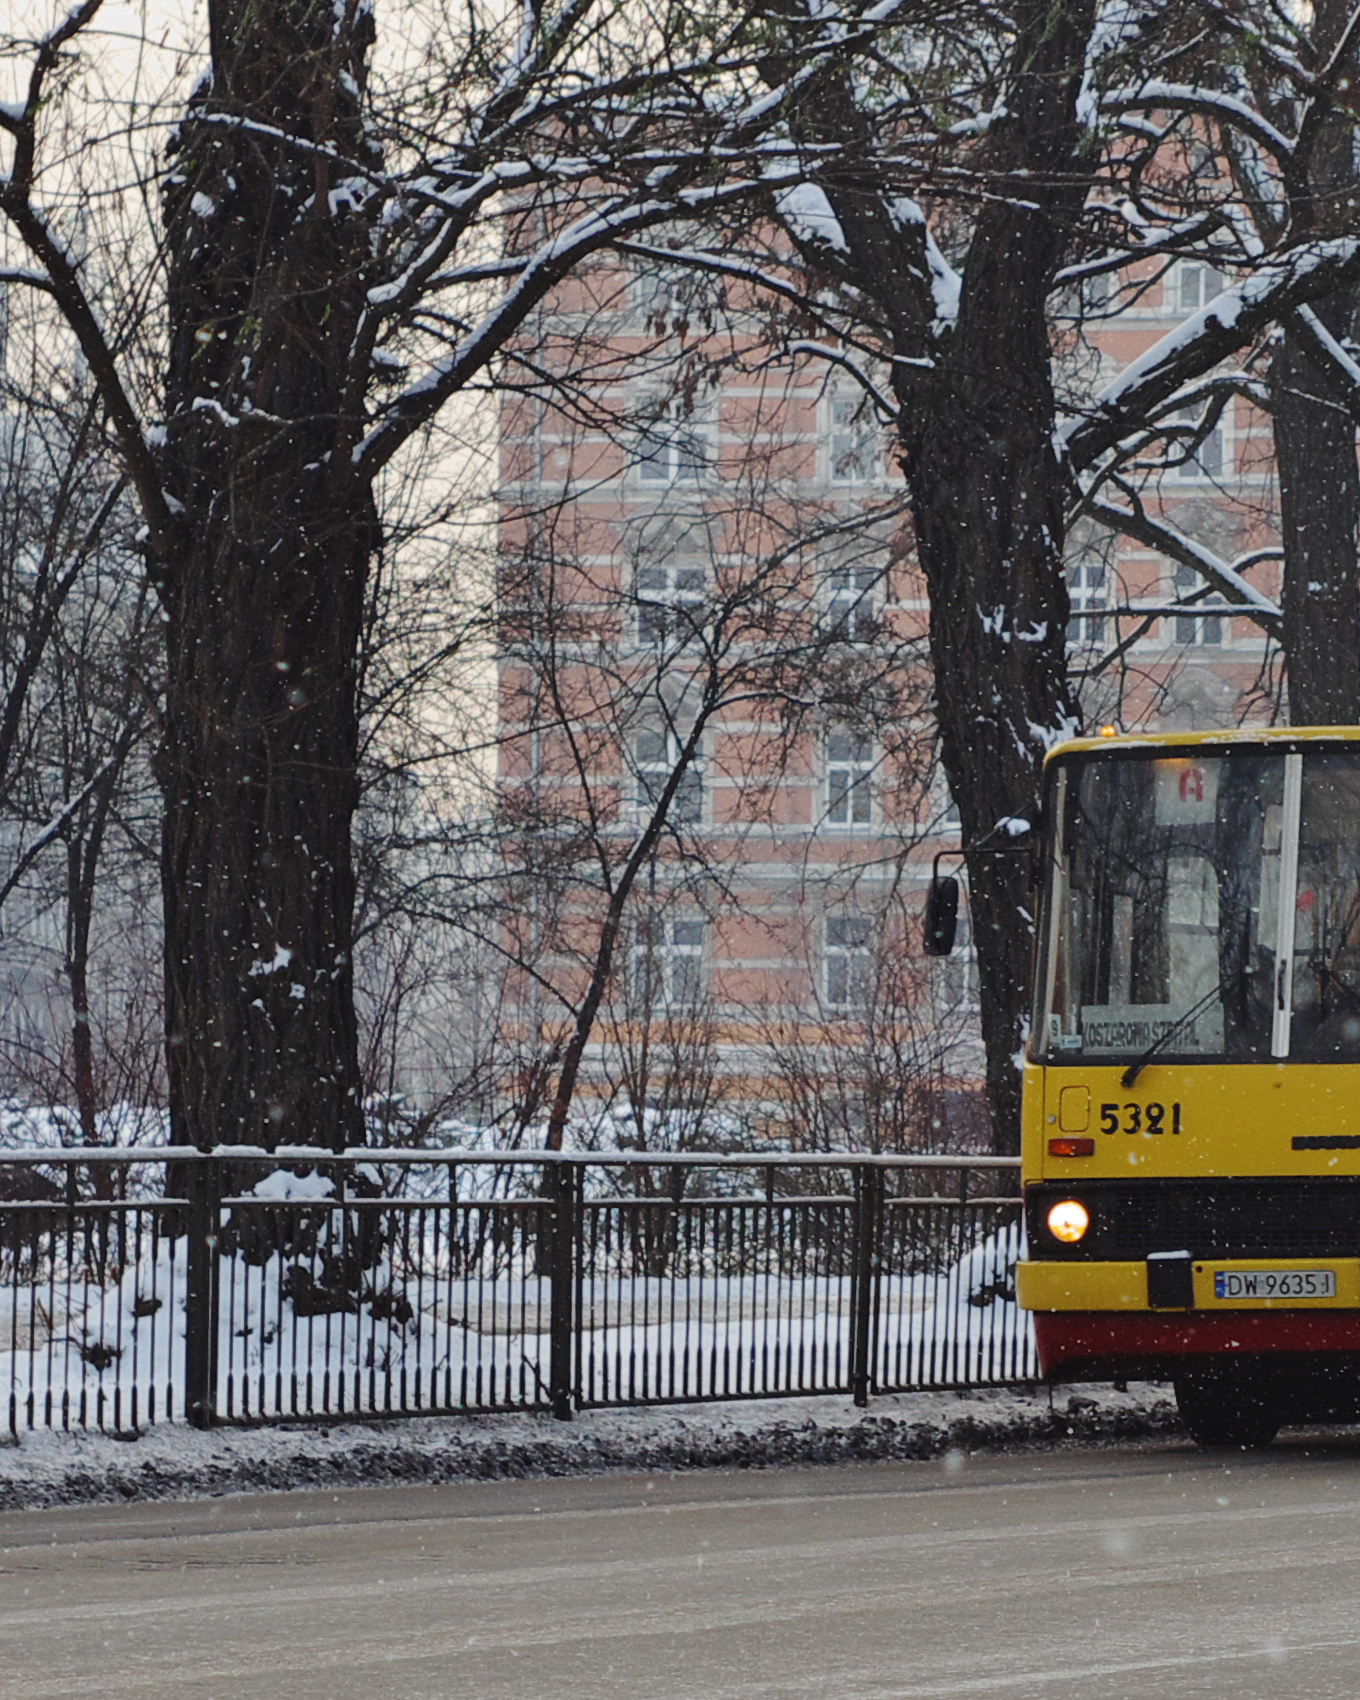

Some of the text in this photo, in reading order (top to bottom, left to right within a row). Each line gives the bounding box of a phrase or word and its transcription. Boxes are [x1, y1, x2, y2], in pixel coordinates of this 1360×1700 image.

[1179, 768, 1203, 803] A
[1100, 1103, 1181, 1135] 5321
[1227, 1273, 1330, 1296] DW 96351
